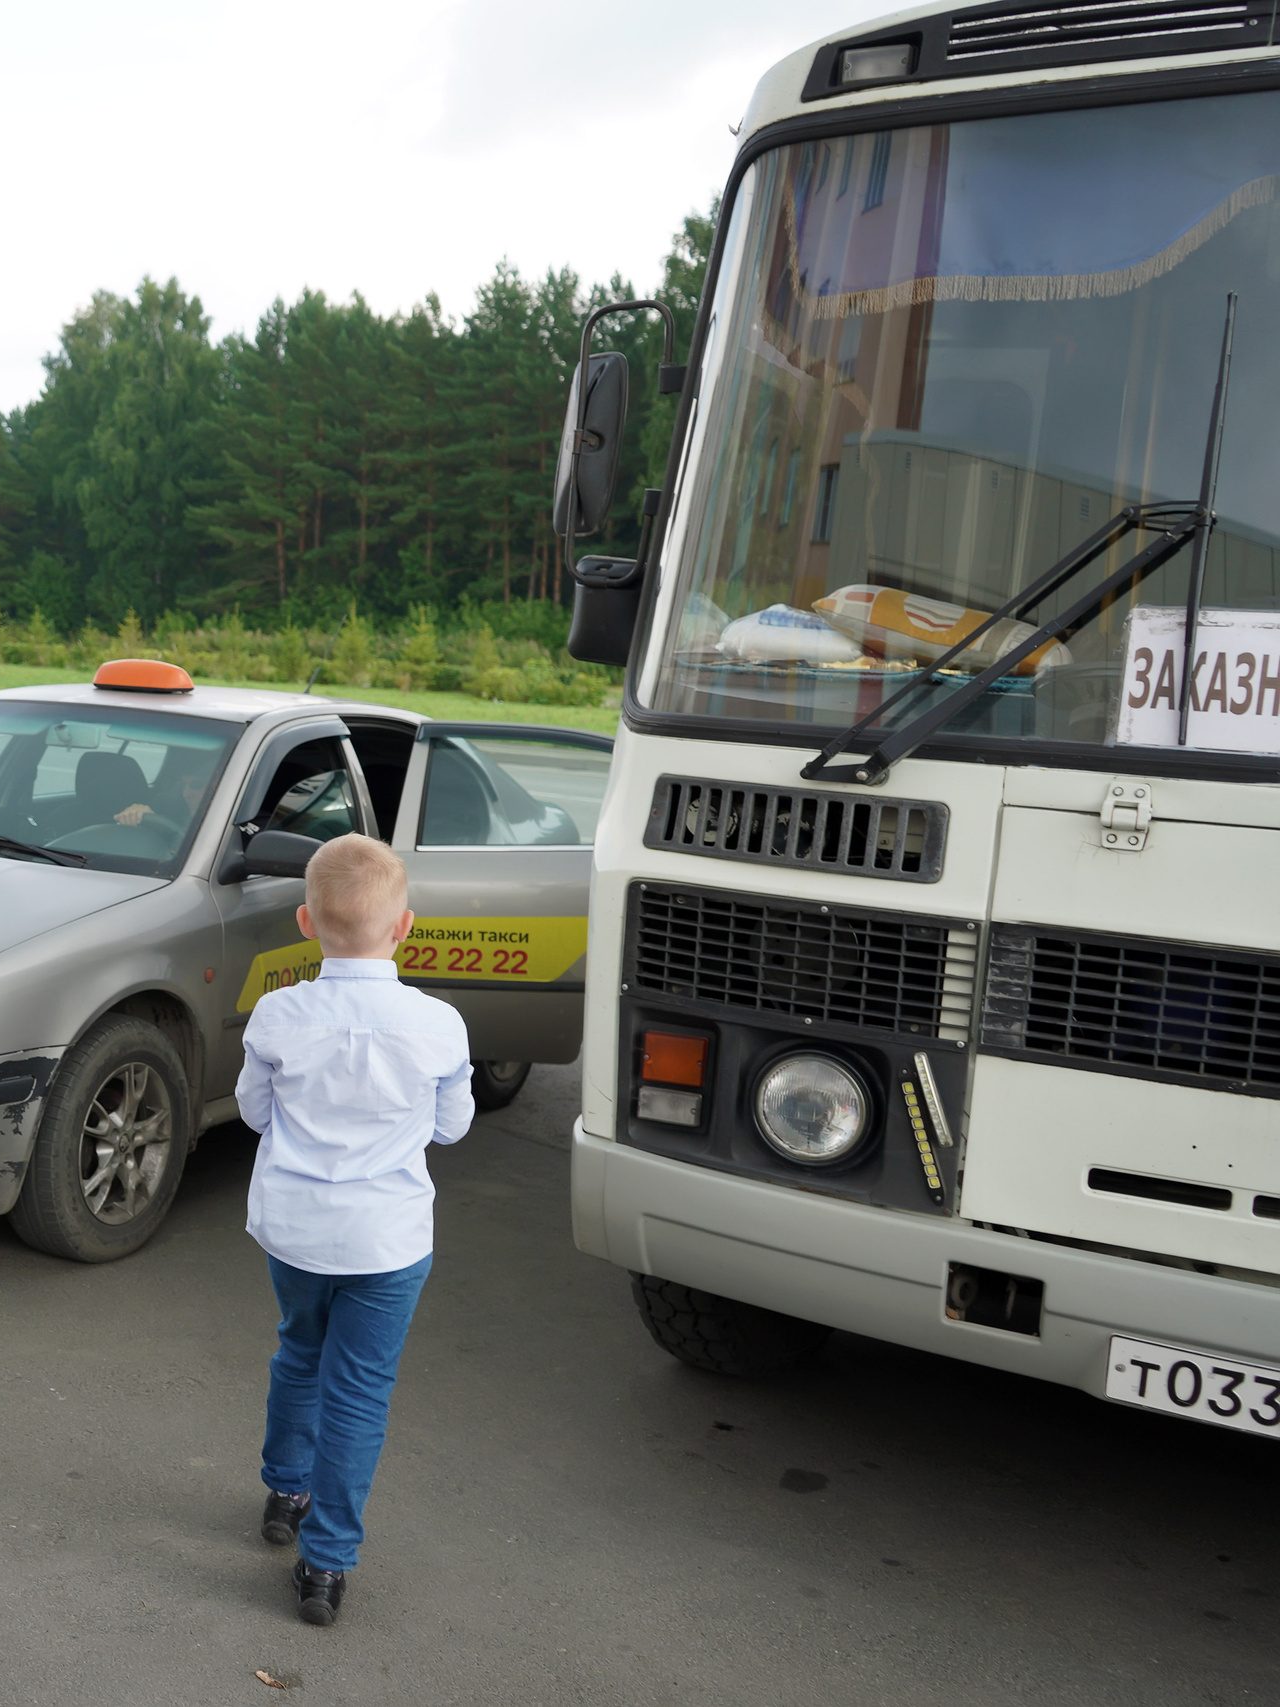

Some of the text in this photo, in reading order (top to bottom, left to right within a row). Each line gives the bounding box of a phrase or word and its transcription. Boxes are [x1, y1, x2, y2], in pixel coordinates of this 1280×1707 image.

[478, 931, 529, 943] такси
[403, 946, 528, 974] 22 22 22
